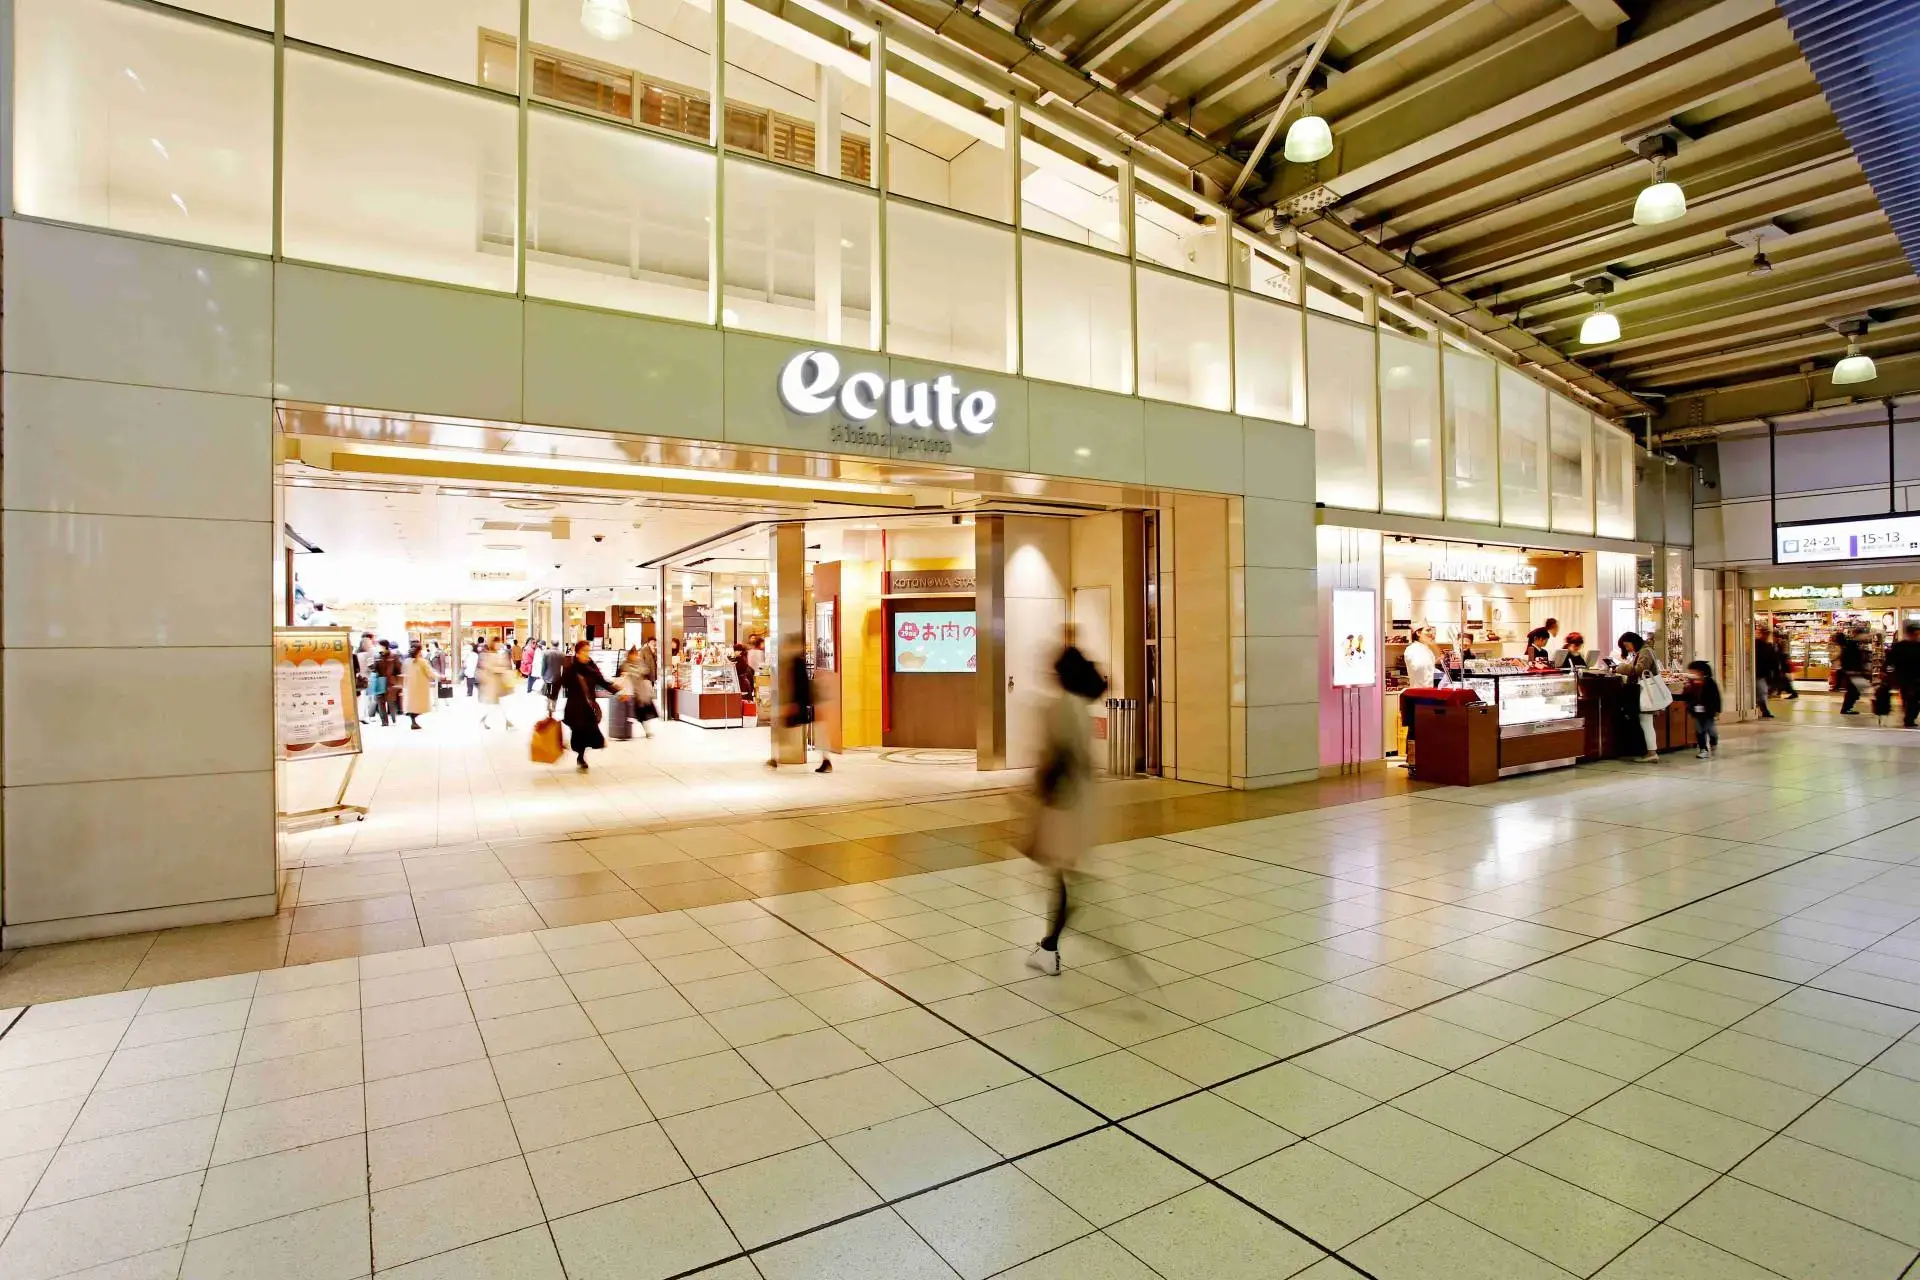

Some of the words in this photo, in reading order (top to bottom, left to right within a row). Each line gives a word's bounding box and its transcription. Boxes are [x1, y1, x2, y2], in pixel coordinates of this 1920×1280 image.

[780, 350, 996, 434] ecute
[893, 577, 951, 589] KOTONOWA
[922, 621, 976, 641] お肉の
